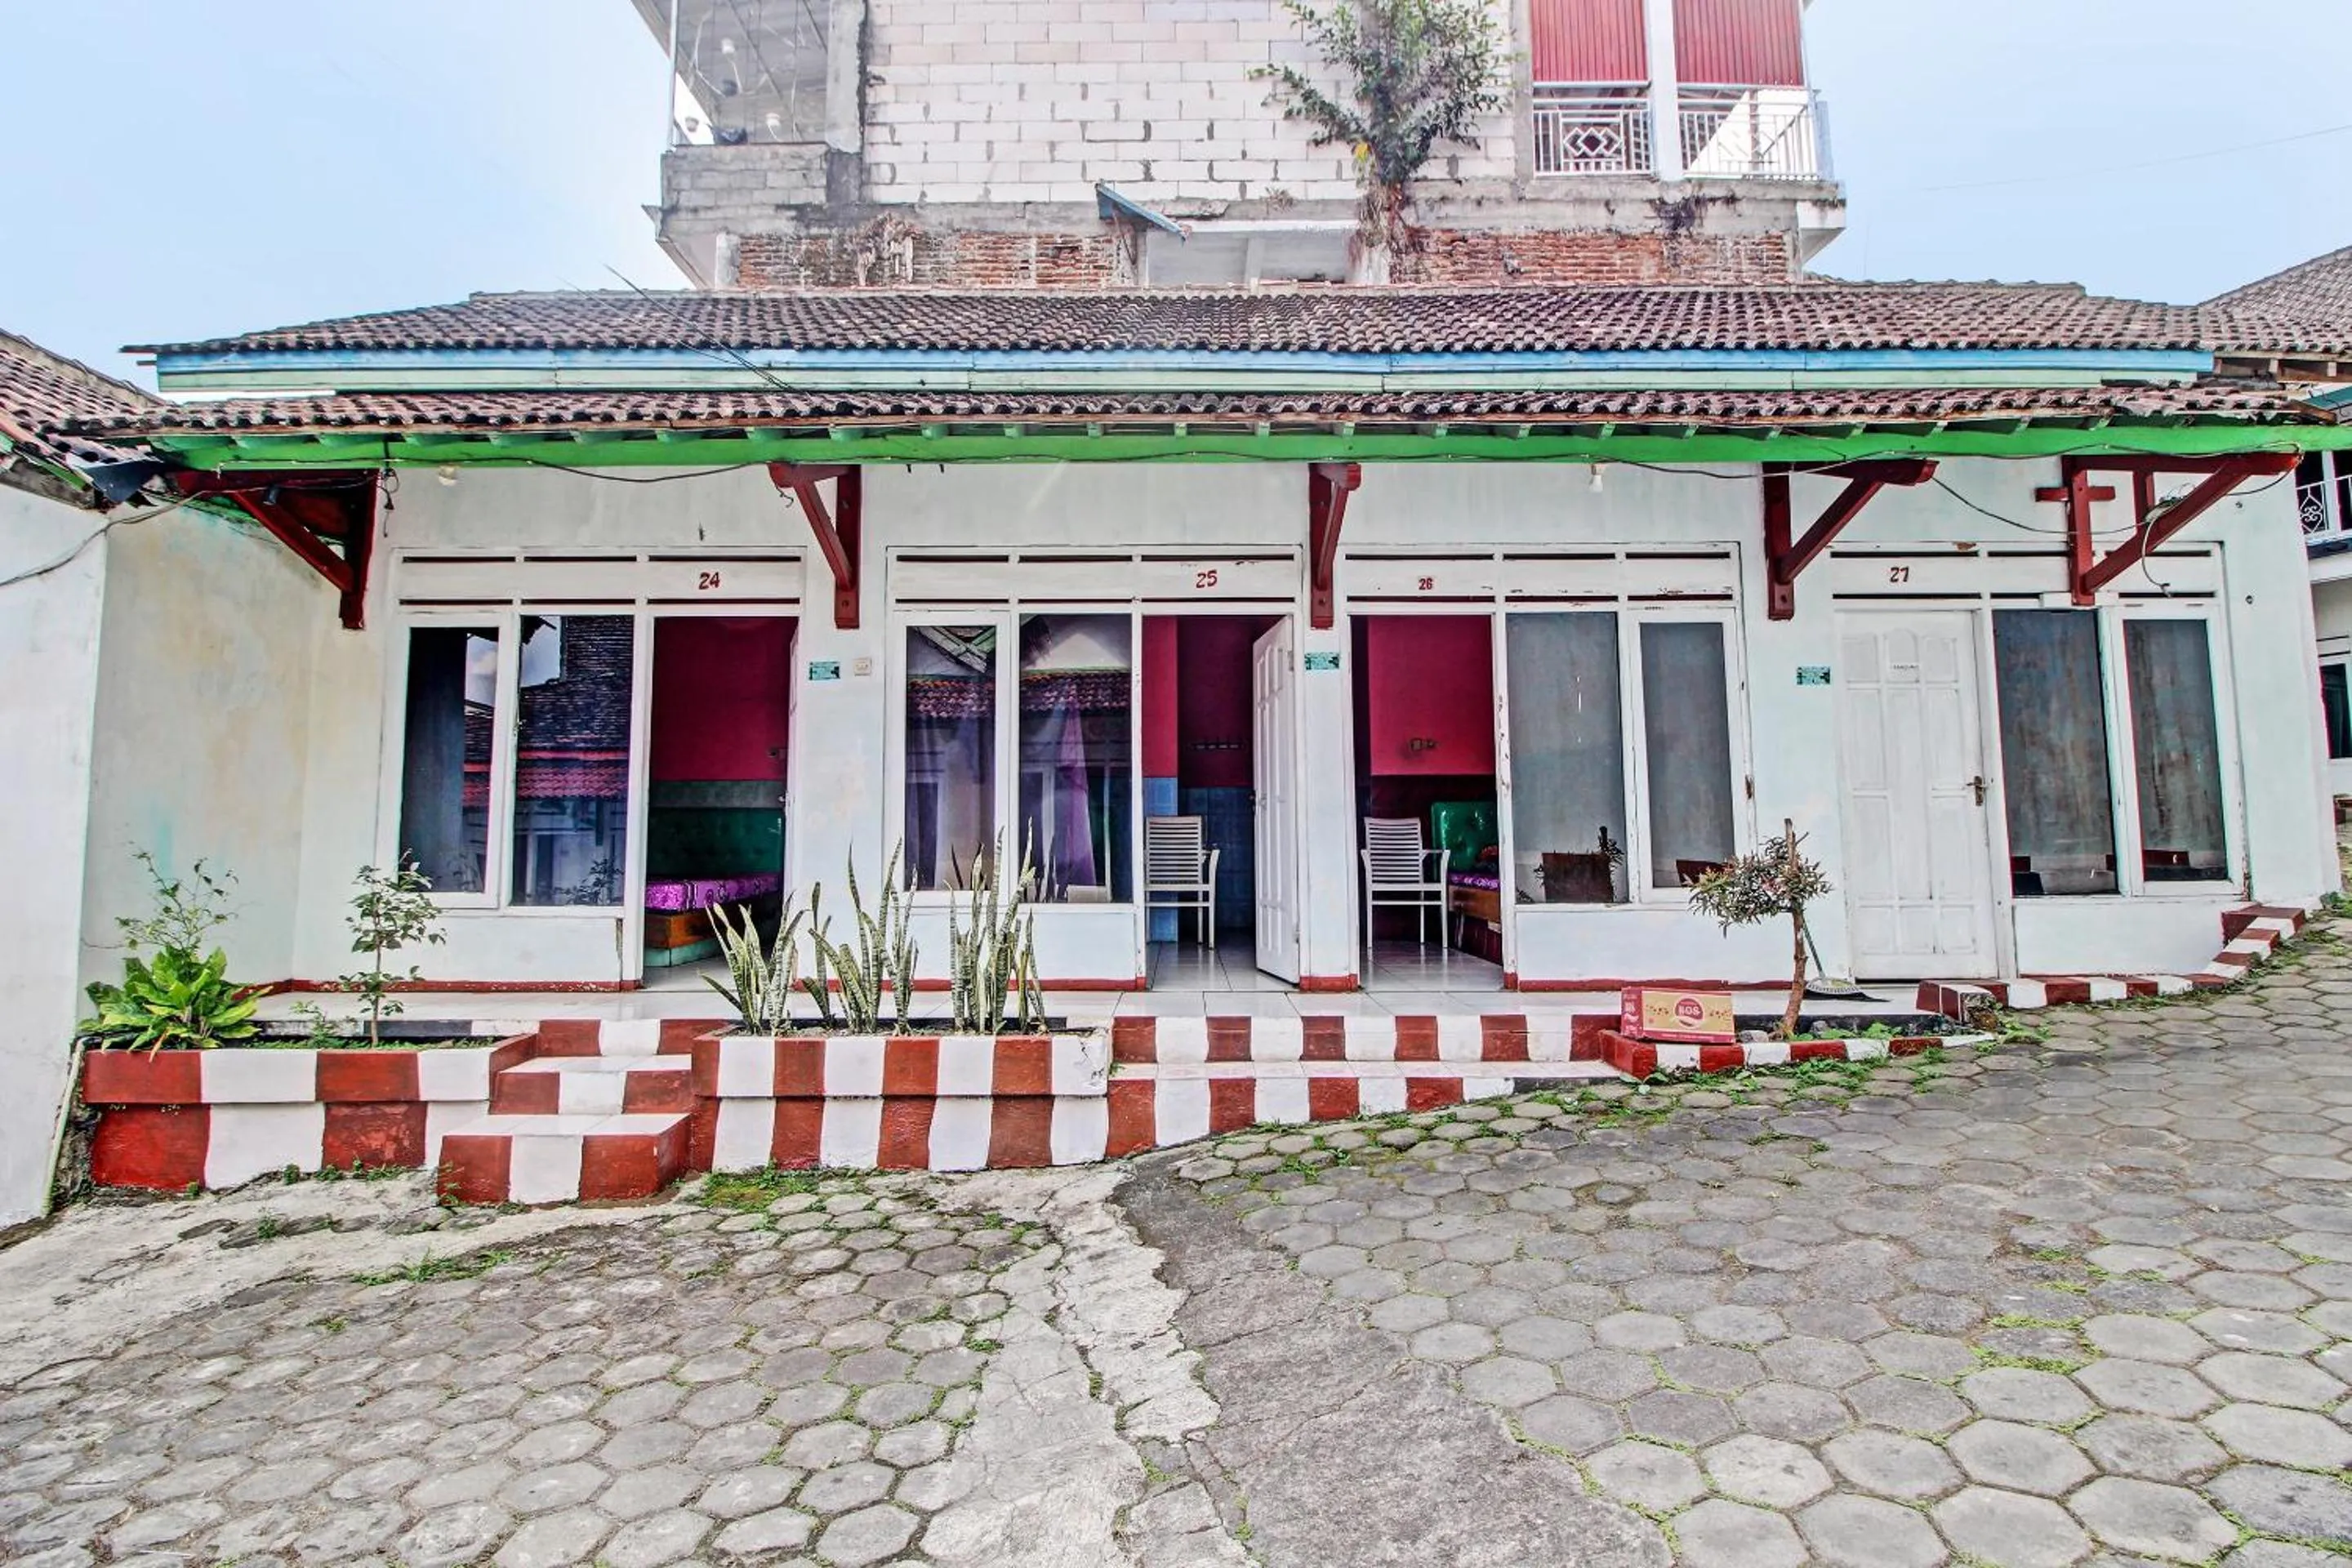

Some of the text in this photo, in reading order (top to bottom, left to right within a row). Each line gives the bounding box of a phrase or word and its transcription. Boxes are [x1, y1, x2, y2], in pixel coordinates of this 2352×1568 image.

[698, 572, 719, 590] 24
[1196, 569, 1217, 588] 25
[1890, 566, 1909, 582] 27
[1419, 577, 1432, 590] 26
